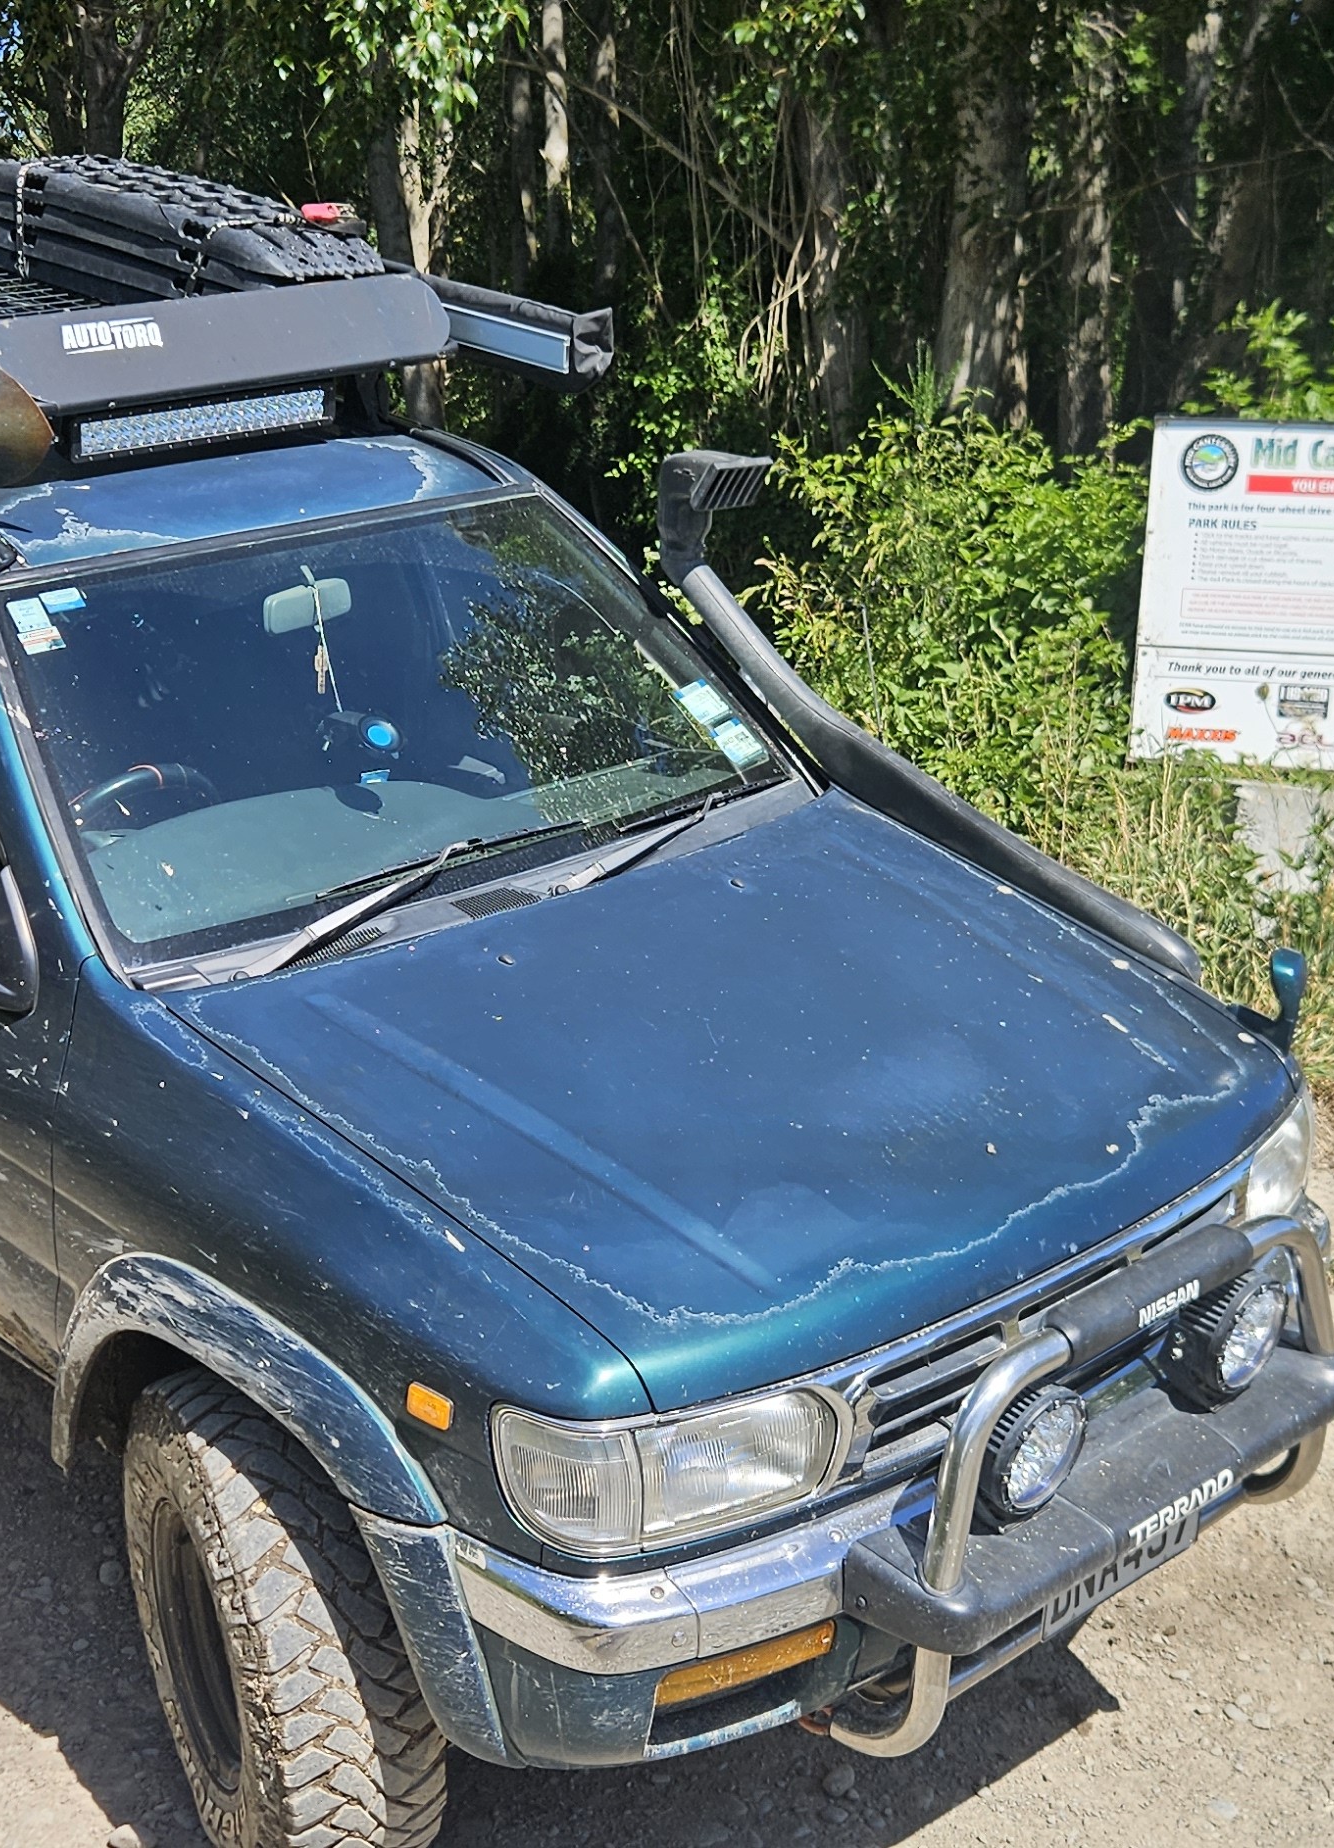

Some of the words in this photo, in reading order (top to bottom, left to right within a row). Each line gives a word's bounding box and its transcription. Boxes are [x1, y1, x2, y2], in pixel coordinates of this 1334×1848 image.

[1251, 438, 1299, 469] Mid
[1291, 479, 1316, 494] YOU
[1187, 502, 1206, 511] This
[1208, 503, 1229, 513] park
[1230, 504, 1239, 512] is
[1240, 504, 1255, 513] for
[1256, 505, 1276, 513] four
[1277, 505, 1306, 514] wheel
[1307, 506, 1332, 515] drive
[1188, 518, 1218, 529] PARK
[1221, 519, 1258, 531] RULES
[1168, 662, 1202, 673] Thank
[1203, 665, 1226, 676] you
[1229, 665, 1242, 675] to
[1244, 665, 1260, 676] all
[1262, 666, 1276, 679] of
[1277, 669, 1297, 678] our
[1166, 726, 1238, 743] MAXXIS
[1138, 1279, 1201, 1329] NISSAN
[1128, 1468, 1234, 1547] TERRANO
